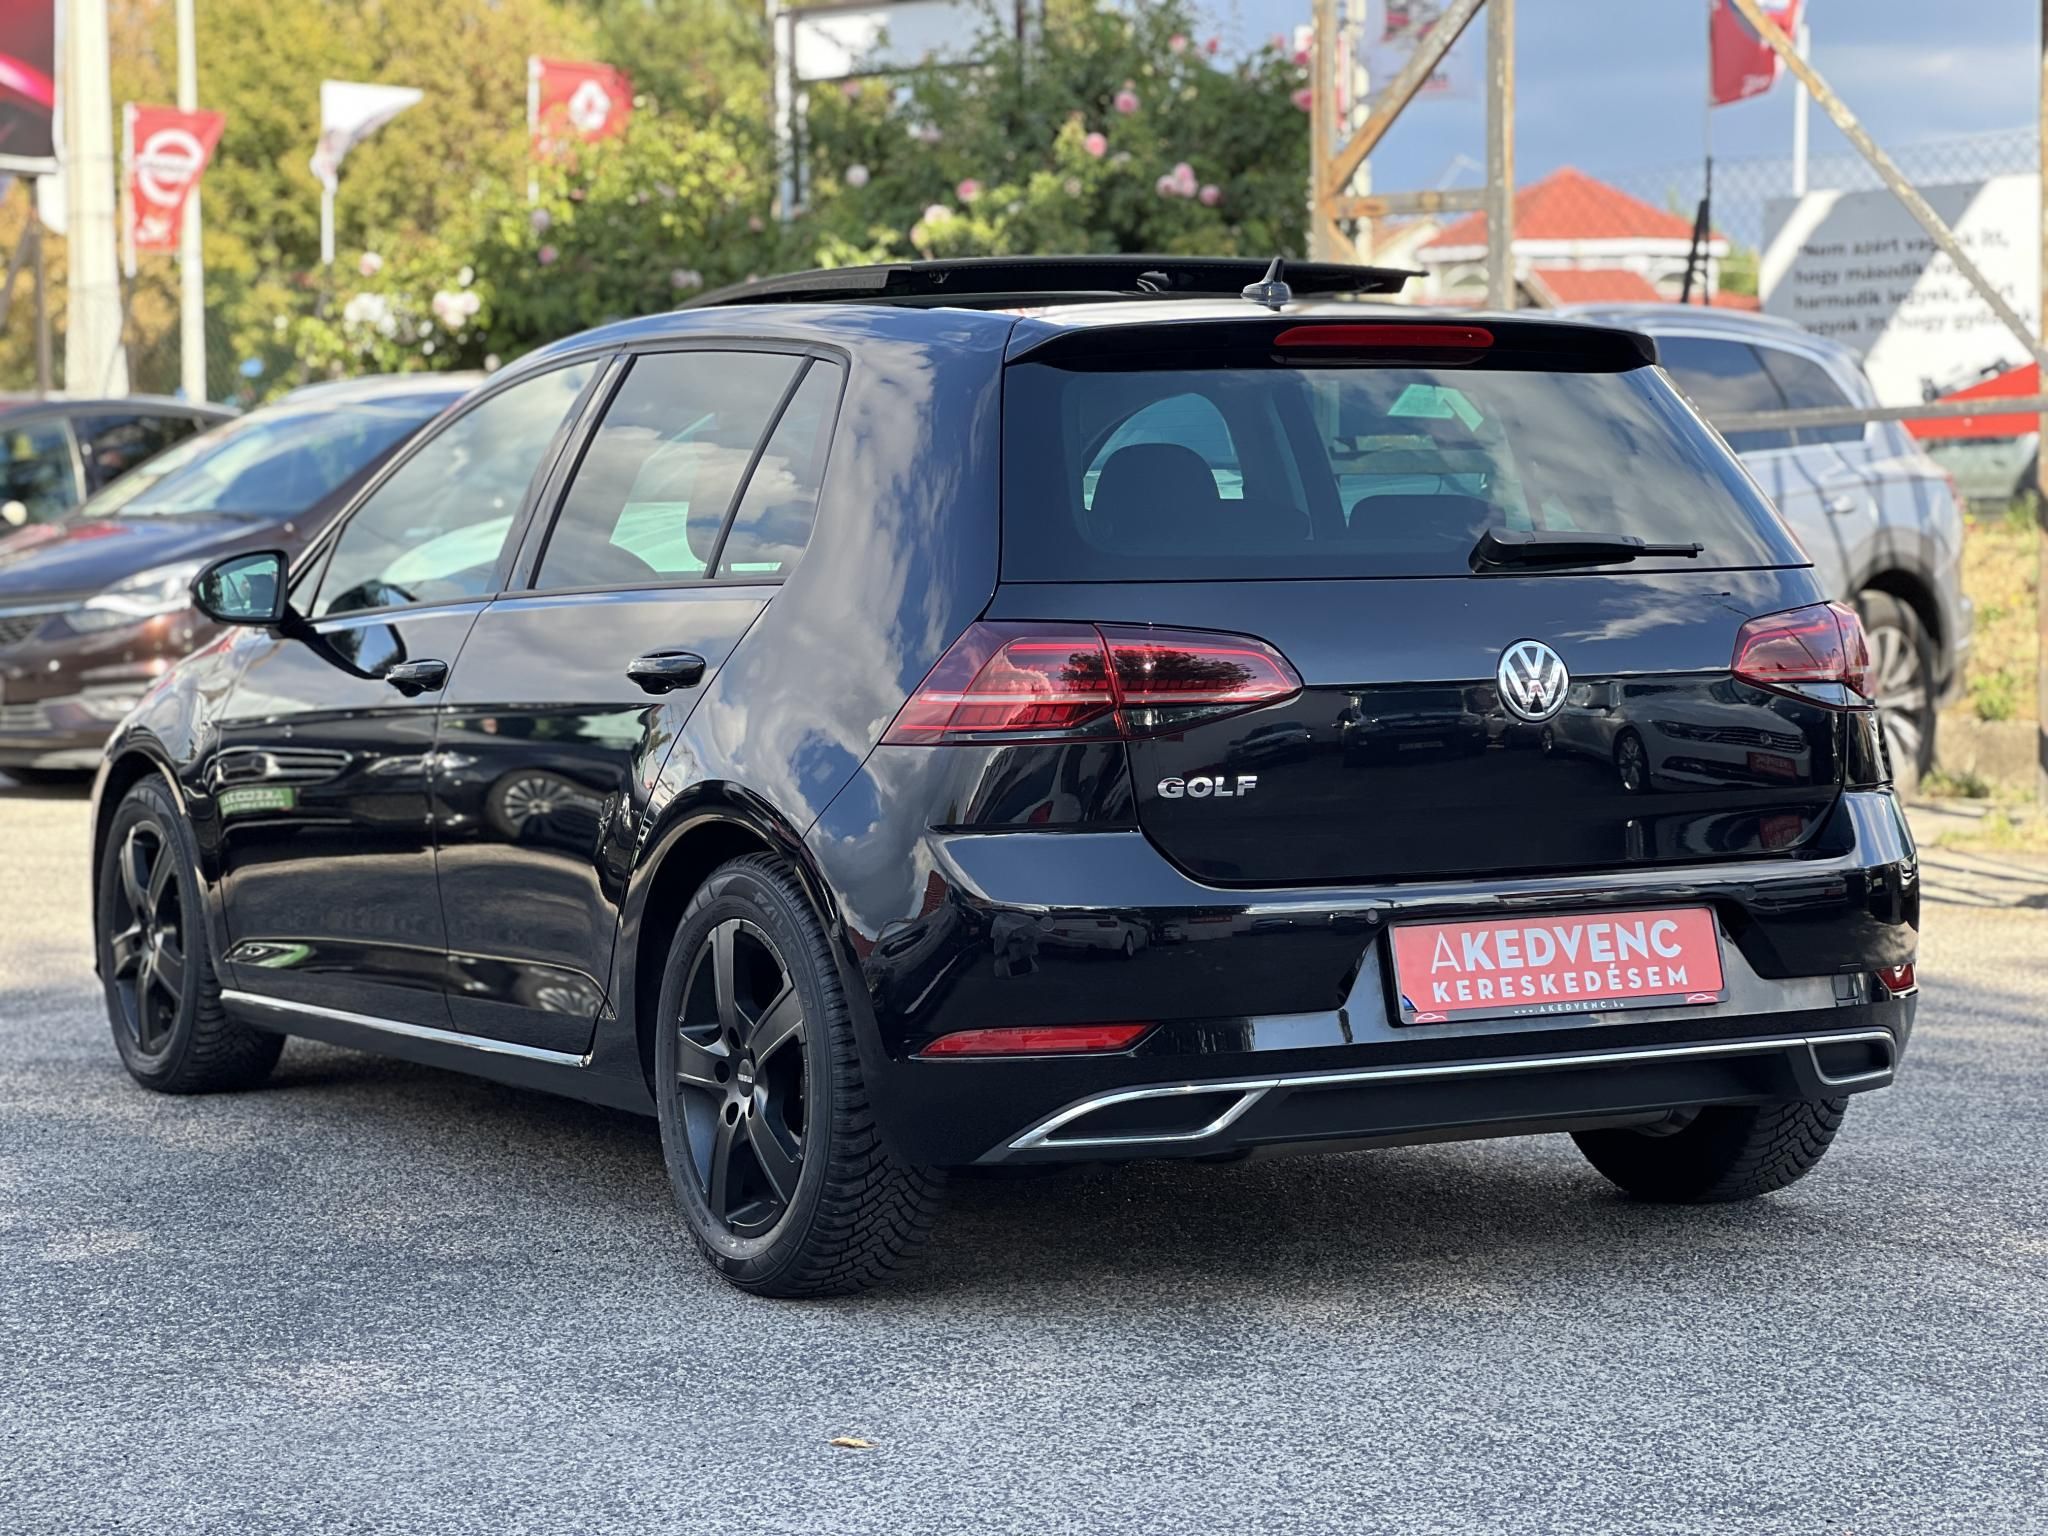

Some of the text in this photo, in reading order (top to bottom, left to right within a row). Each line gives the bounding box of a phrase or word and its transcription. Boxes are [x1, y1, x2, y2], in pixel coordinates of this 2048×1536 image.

[1157, 775, 1258, 799] GOLF
[1431, 919, 1682, 975] AKEDVENC
[1432, 963, 1689, 1003] KERESKEDÉSEM
